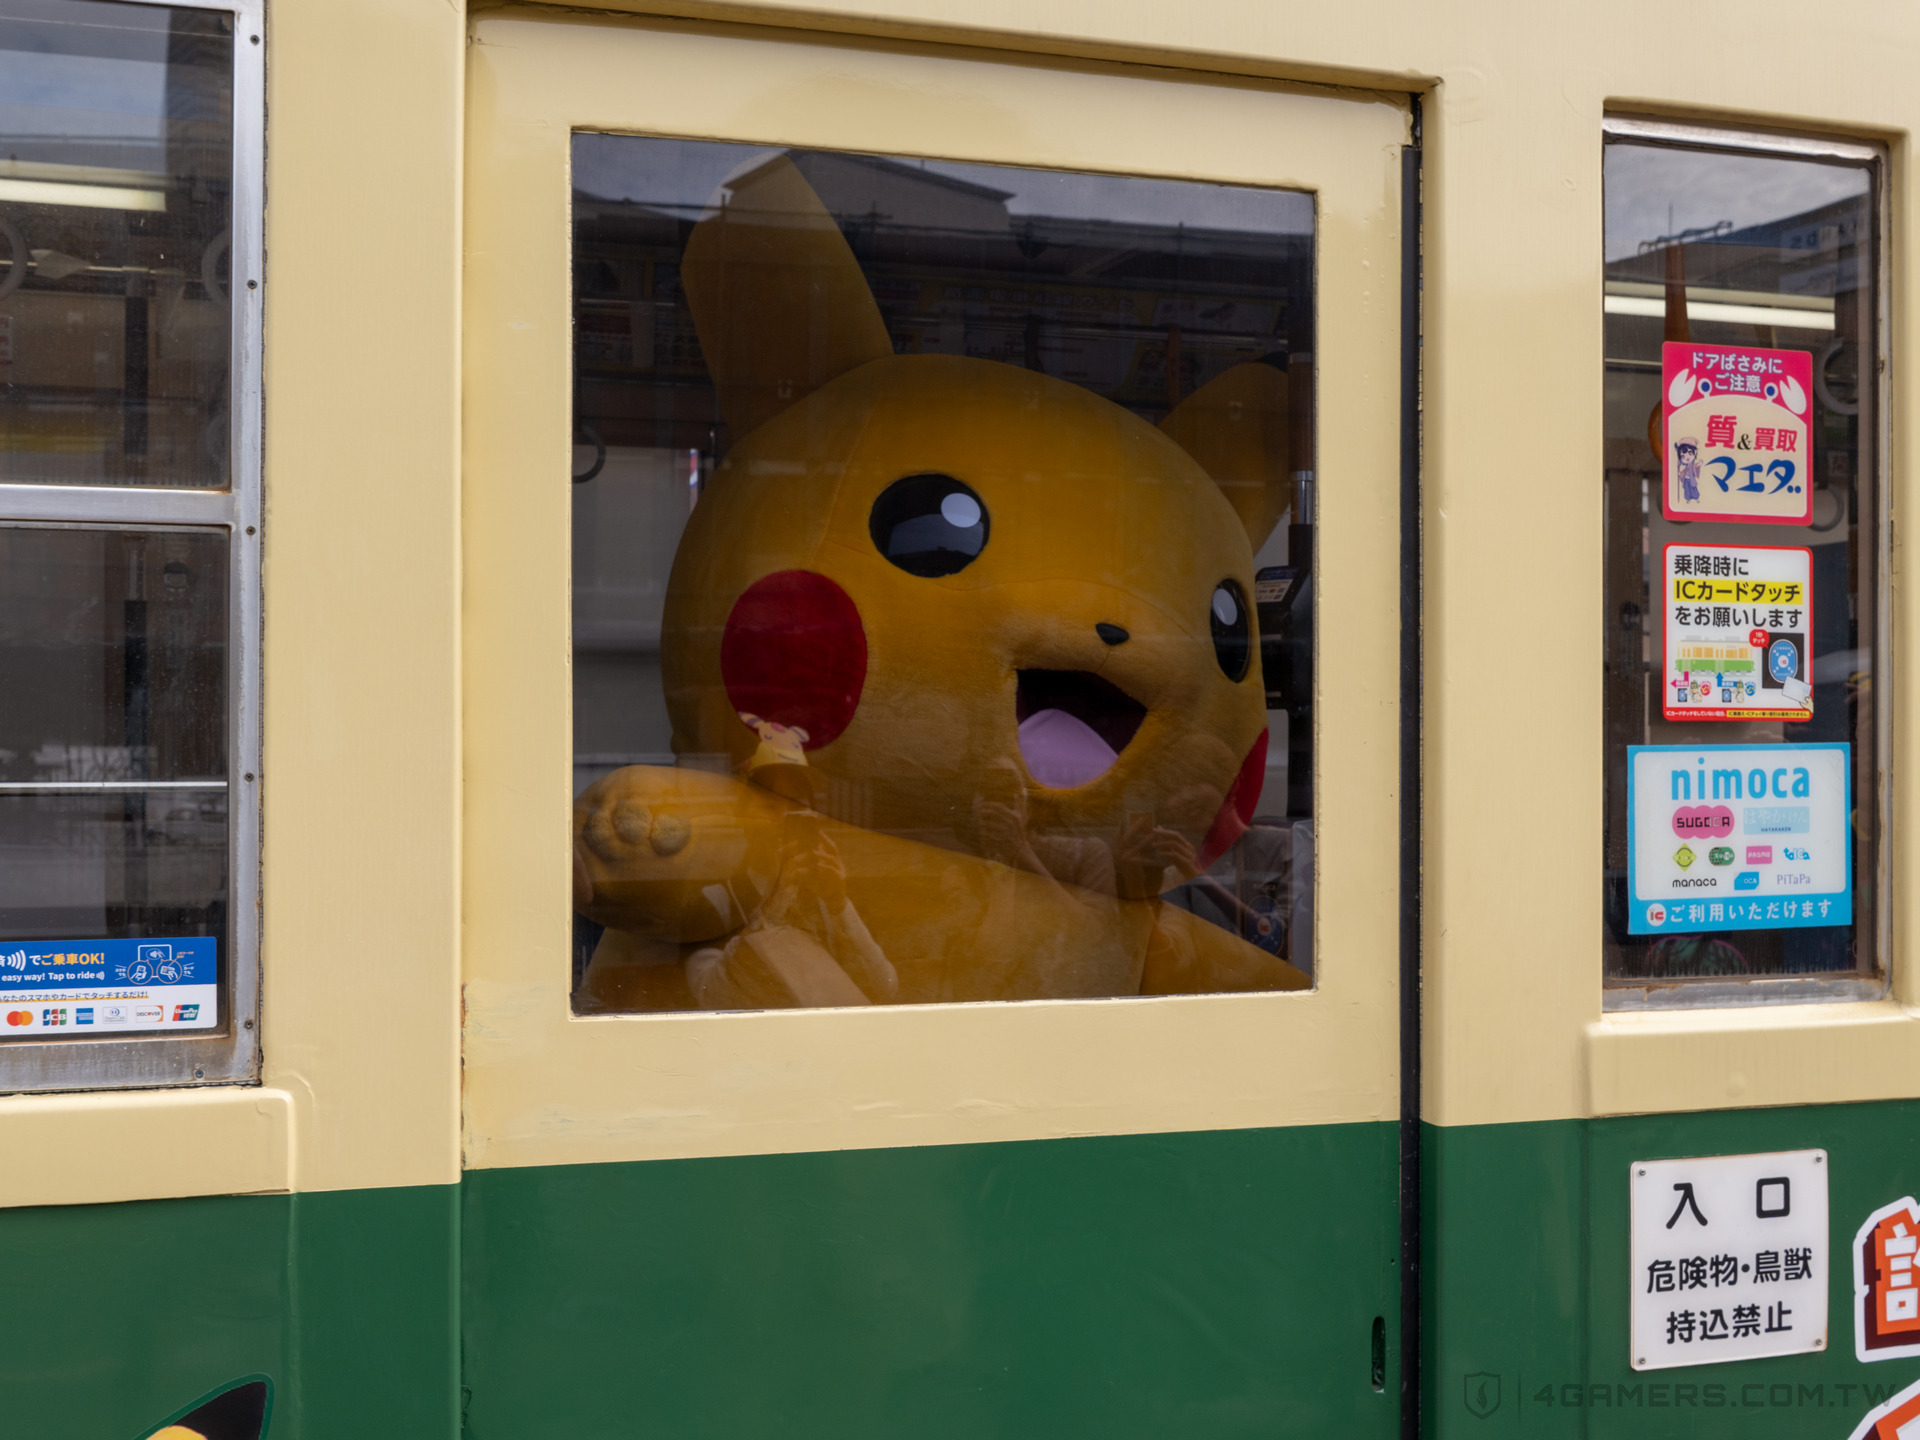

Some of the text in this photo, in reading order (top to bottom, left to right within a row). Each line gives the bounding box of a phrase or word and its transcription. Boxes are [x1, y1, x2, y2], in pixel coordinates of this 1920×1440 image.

[1692, 352, 1783, 374] ドアばさみに
[1714, 374, 1762, 393] ご注意
[1674, 554, 1749, 577] 乗降時に
[1675, 580, 1801, 603] ICカードタッチ
[1674, 605, 1802, 628] をお願いします
[1671, 757, 1810, 800] nimoca
[1676, 816, 1730, 828] SUGOCA
[1672, 878, 1717, 888] manaca
[1776, 873, 1811, 886] PiTaPa
[1670, 899, 1832, 923] ご利用いただけます
[1, 971, 95, 983] easy way! Tap to ride
[0, 990, 148, 1002] なたのスマホやカードでタッチするだけ!
[43, 1012, 67, 1021] JCB
[1646, 1247, 1812, 1294] 危険物・鳥獣
[1666, 1300, 1793, 1344] 持込禁止
